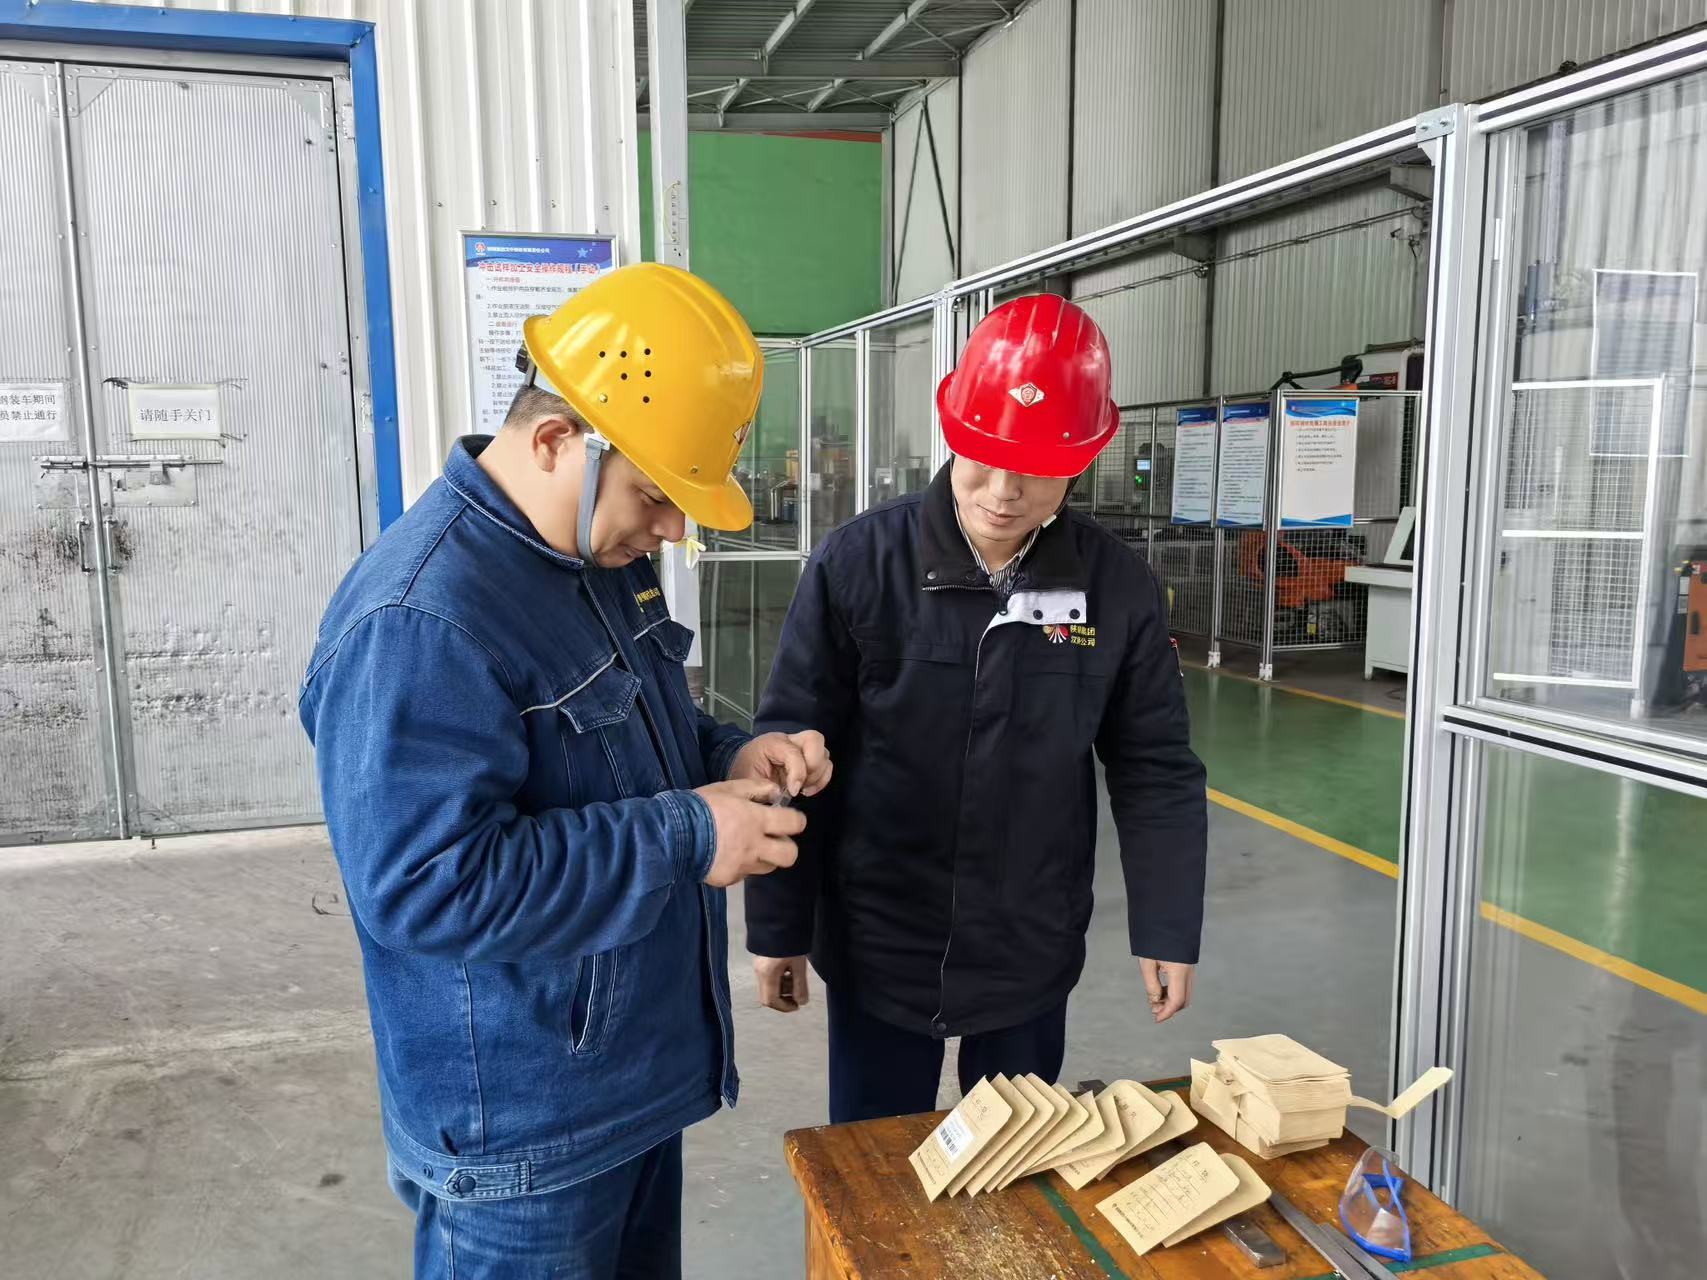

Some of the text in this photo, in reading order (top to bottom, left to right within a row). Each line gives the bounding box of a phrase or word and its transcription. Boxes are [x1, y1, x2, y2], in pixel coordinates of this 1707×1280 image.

[0, 410, 57, 421] 员禁止通行
[139, 408, 212, 422] 请随手关门
